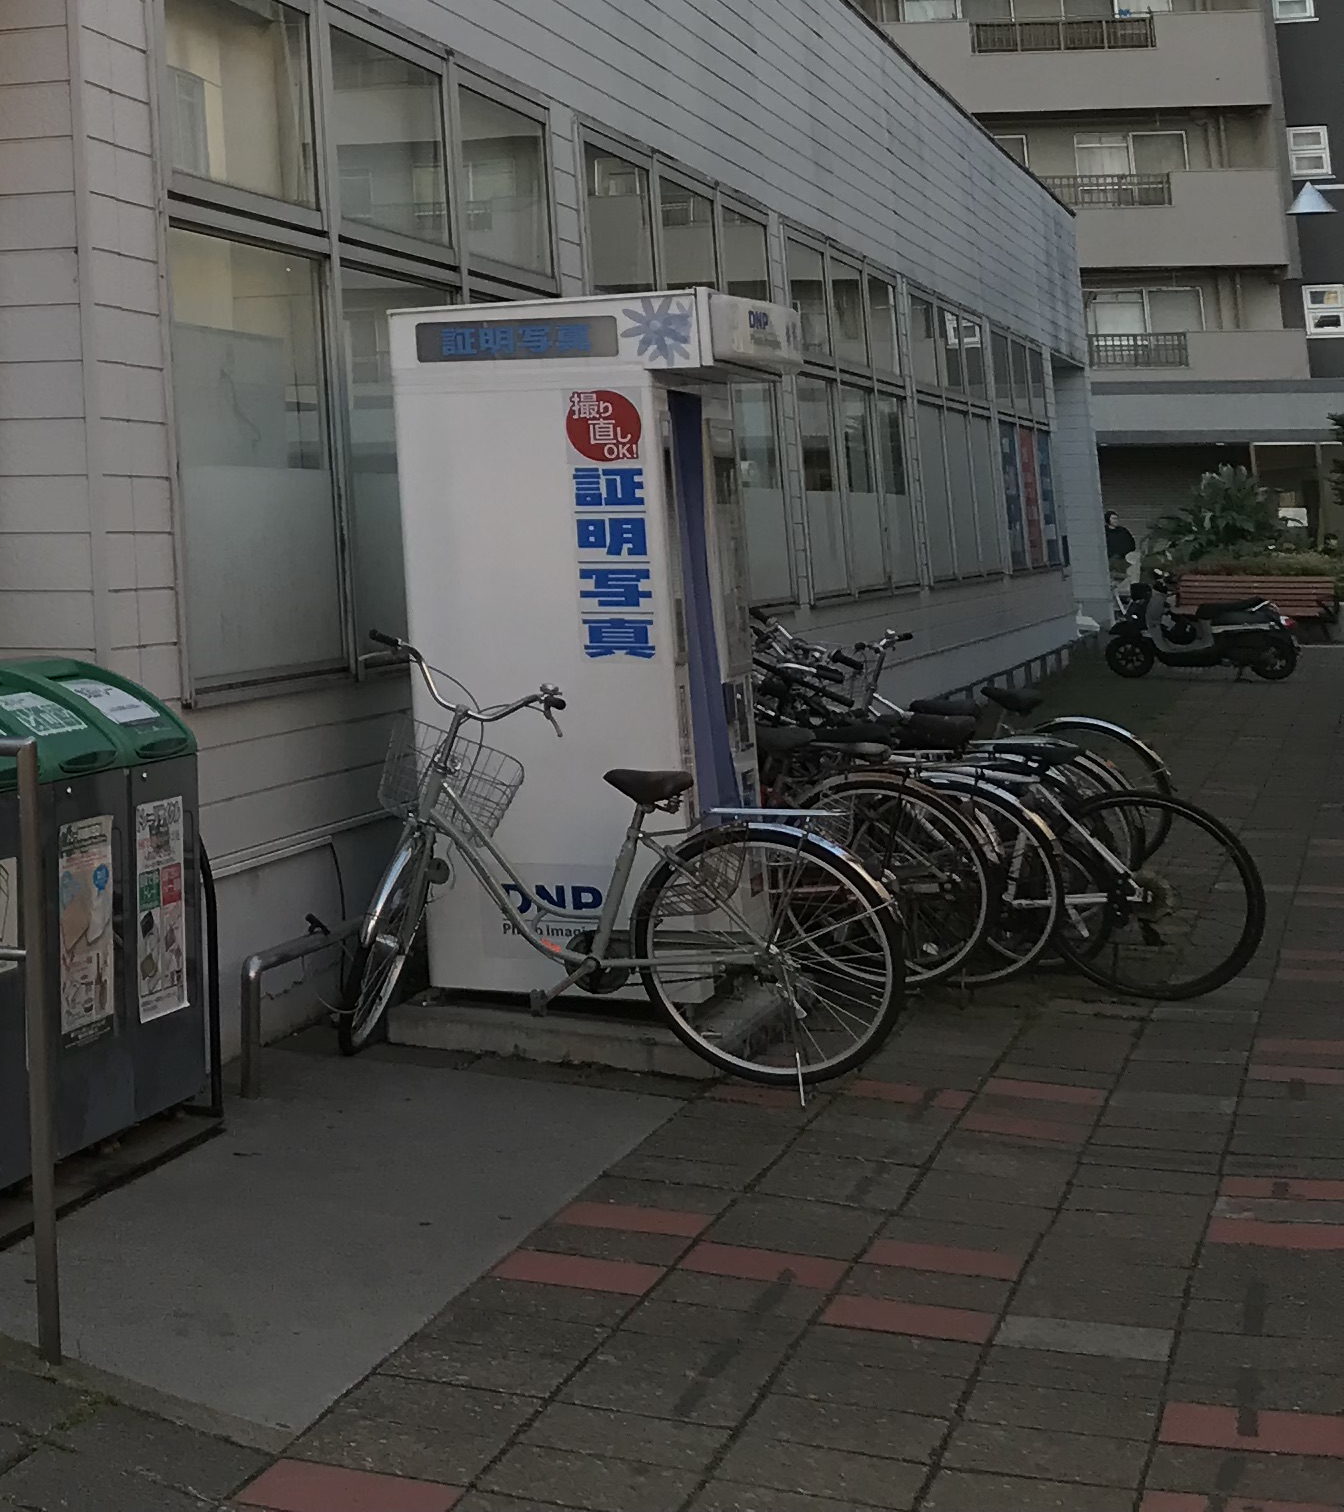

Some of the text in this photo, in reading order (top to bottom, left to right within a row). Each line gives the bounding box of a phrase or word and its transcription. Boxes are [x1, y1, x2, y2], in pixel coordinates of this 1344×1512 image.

[748, 310, 769, 330] DNP
[441, 323, 592, 358] 証明写真
[571, 392, 614, 419] 撮り
[587, 418, 632, 445] 直し
[603, 443, 638, 459] OK!
[572, 467, 656, 659] 証明写真
